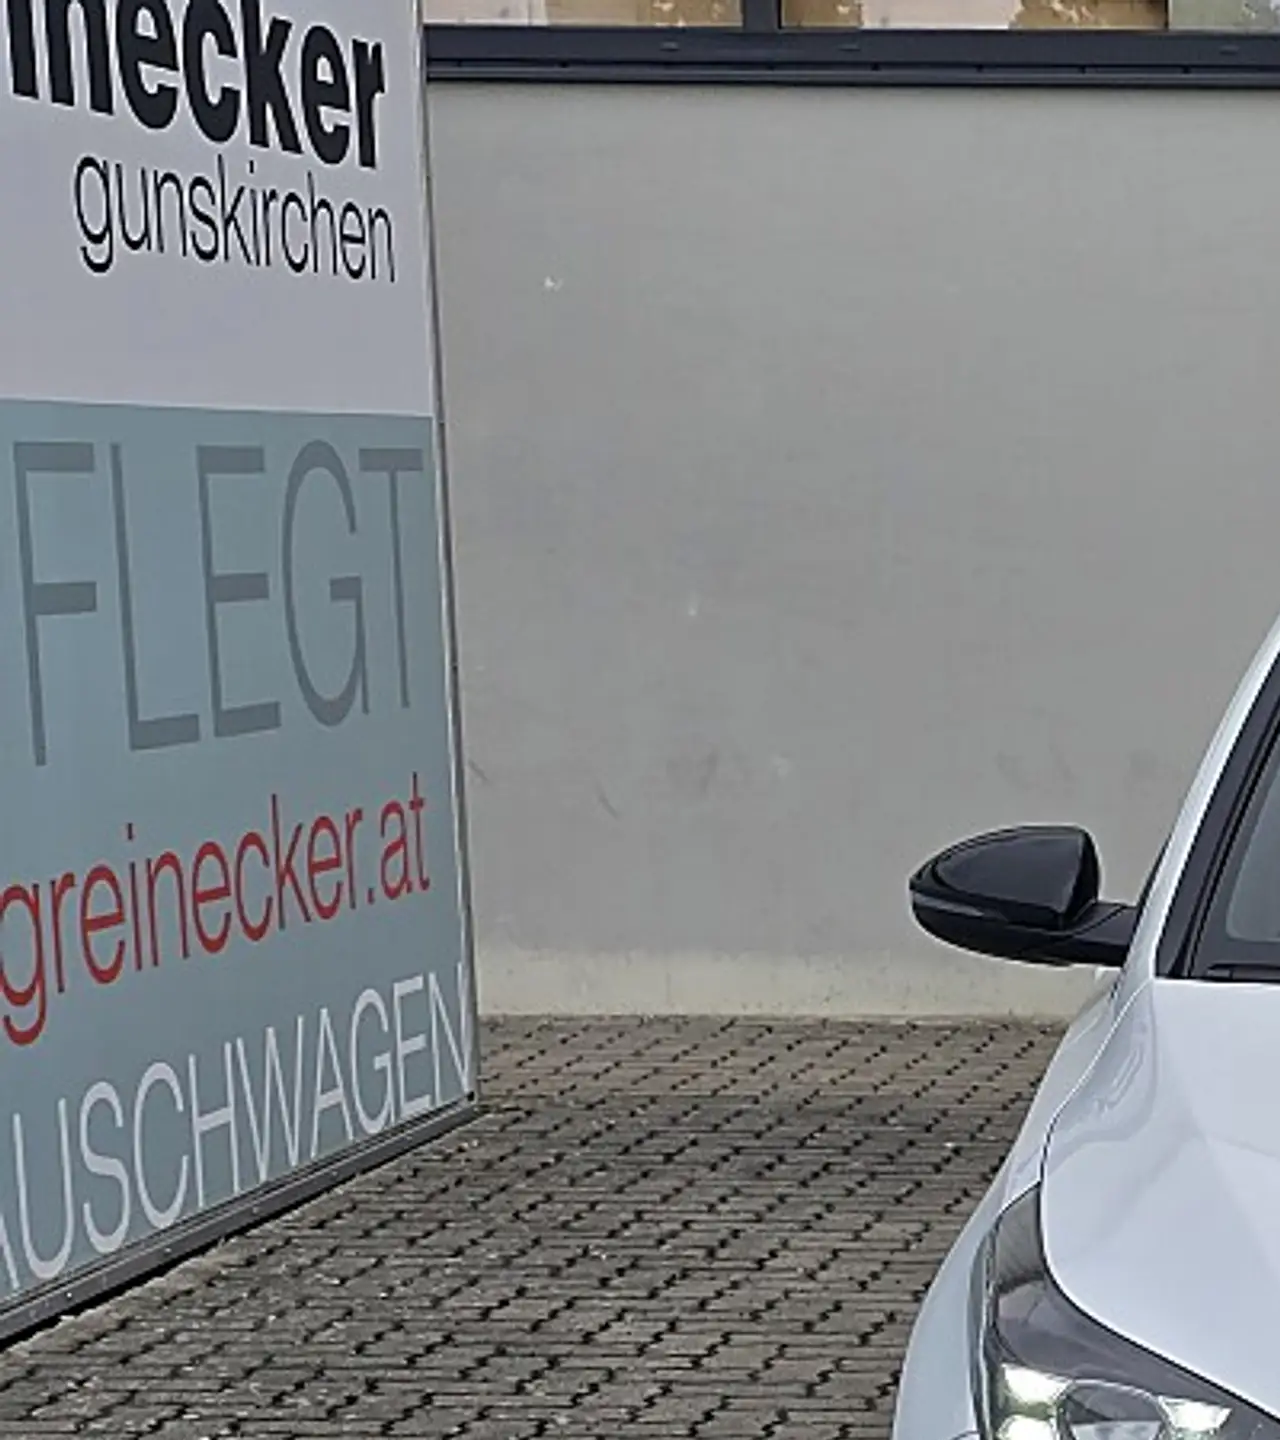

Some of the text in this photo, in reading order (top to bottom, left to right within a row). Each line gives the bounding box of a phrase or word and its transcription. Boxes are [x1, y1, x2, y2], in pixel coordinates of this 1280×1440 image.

[74, 154, 396, 283] gunskirchen
[13, 438, 424, 767] FLEGT
[0, 770, 430, 1046] greinecker.at
[0, 962, 471, 1290] USCHWAGEN
